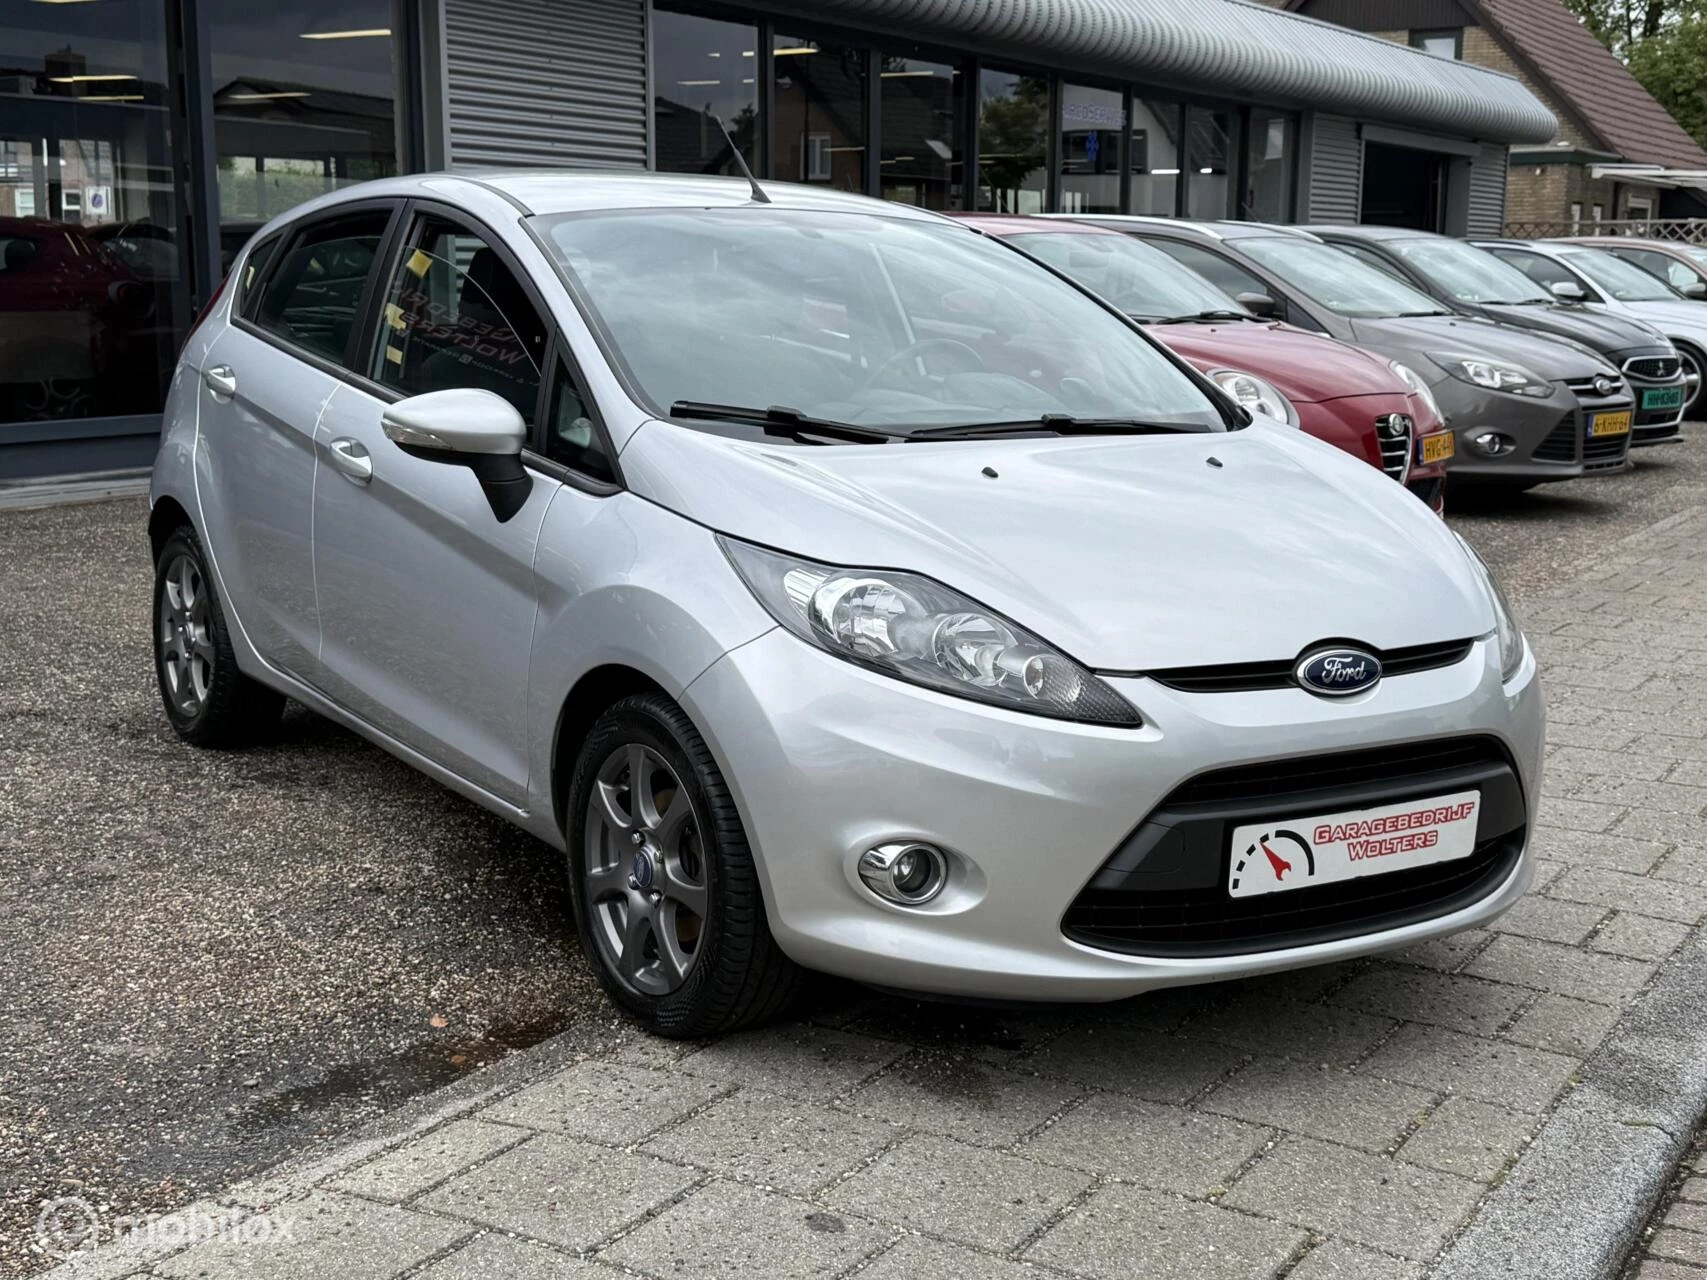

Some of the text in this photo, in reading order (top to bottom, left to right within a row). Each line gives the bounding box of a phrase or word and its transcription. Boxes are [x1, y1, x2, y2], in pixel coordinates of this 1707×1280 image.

[1322, 656, 1367, 684] Ford
[1313, 802, 1475, 845] GARAGEBEDRIJF
[1348, 830, 1438, 861] WOLTERS
